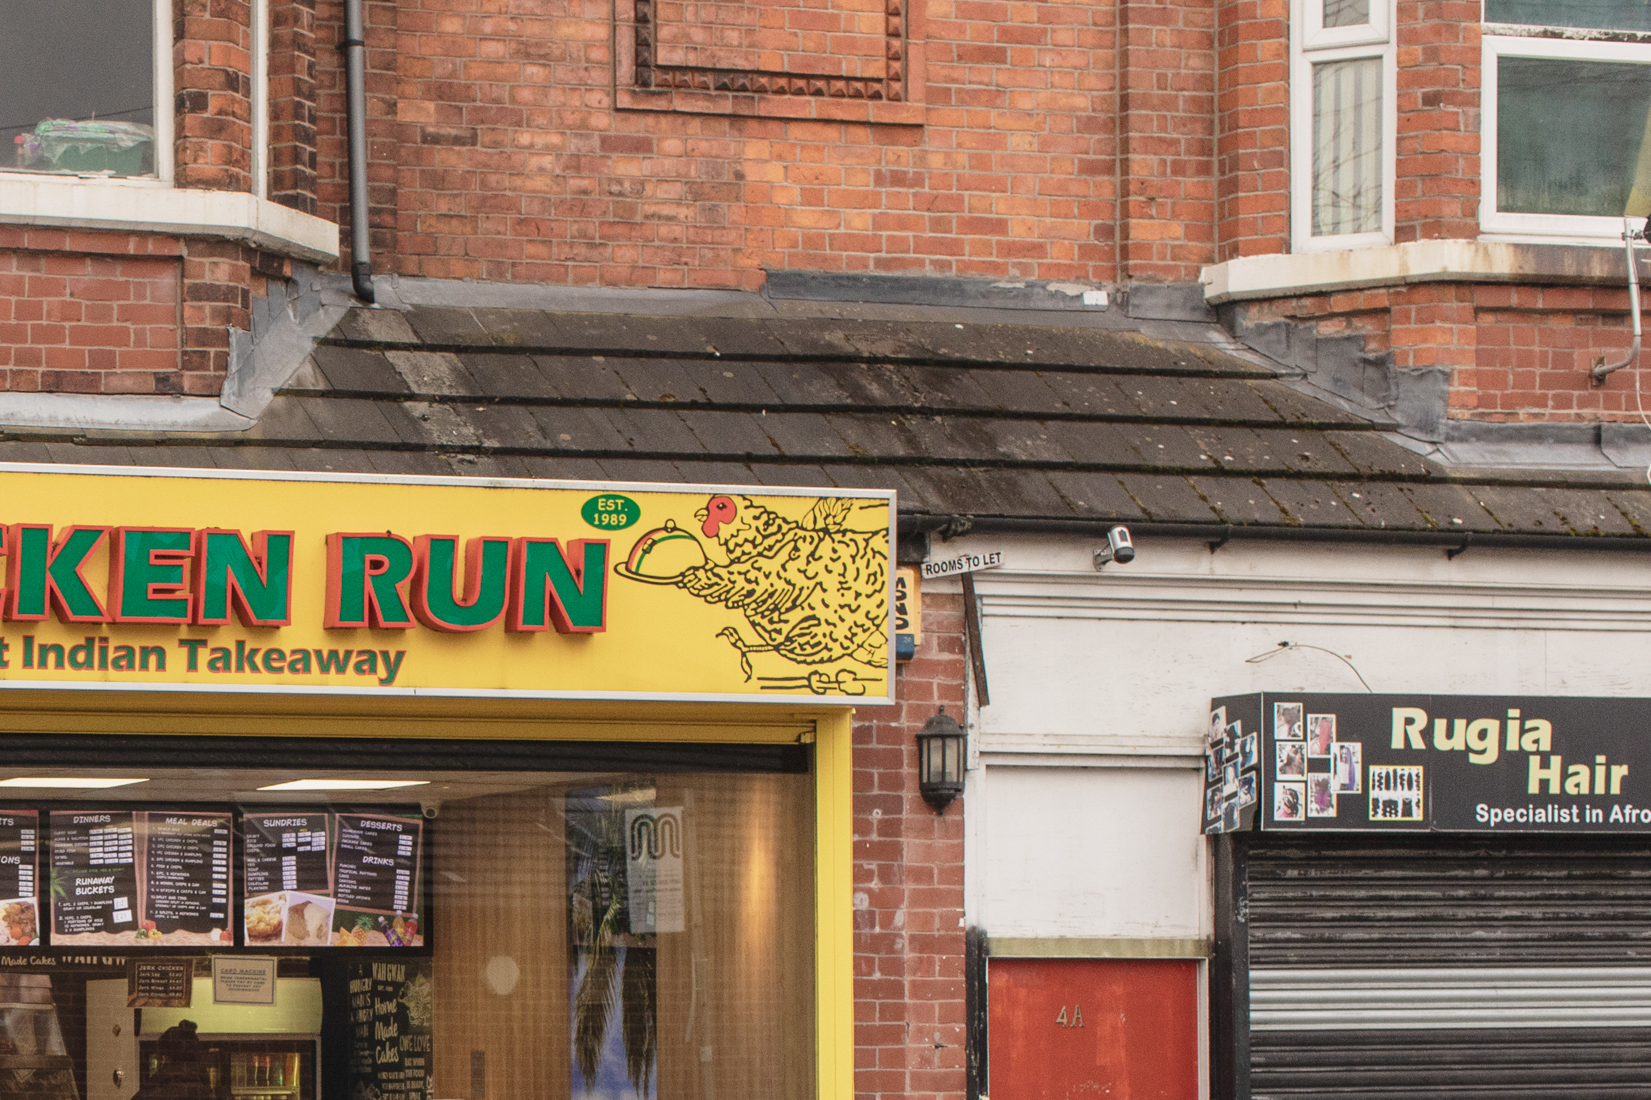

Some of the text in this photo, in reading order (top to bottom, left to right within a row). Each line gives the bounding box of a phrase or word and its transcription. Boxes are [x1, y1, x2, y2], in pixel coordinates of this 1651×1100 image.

[598, 498, 628, 511] EST.
[594, 513, 627, 526] 1989
[925, 551, 1002, 576] ROOMS TO LET
[324, 531, 611, 633] RUN
[22, 635, 167, 672] Indian
[178, 638, 407, 687] Takeaway
[1390, 707, 1552, 765] Rugia
[1527, 755, 1629, 795] Hair
[73, 815, 111, 824] DINNERS
[165, 818, 218, 827] MEAL DEALS
[263, 819, 308, 828] SUNDRIES
[1475, 804, 1651, 827] Specialist in Afro
[360, 821, 403, 832] DESSERTS
[362, 856, 394, 866] DRINKS
[75, 876, 115, 886] RUNAWAY
[76, 886, 115, 896] BUCKETS
[0, 956, 28, 966] Made
[30, 956, 56, 966] Cakes
[375, 997, 398, 1016] Home
[1056, 1005, 1085, 1028] 4A
[375, 1016, 398, 1041] Made
[399, 1035, 431, 1052] ONE LOVE
[376, 1042, 399, 1064] Cakes
